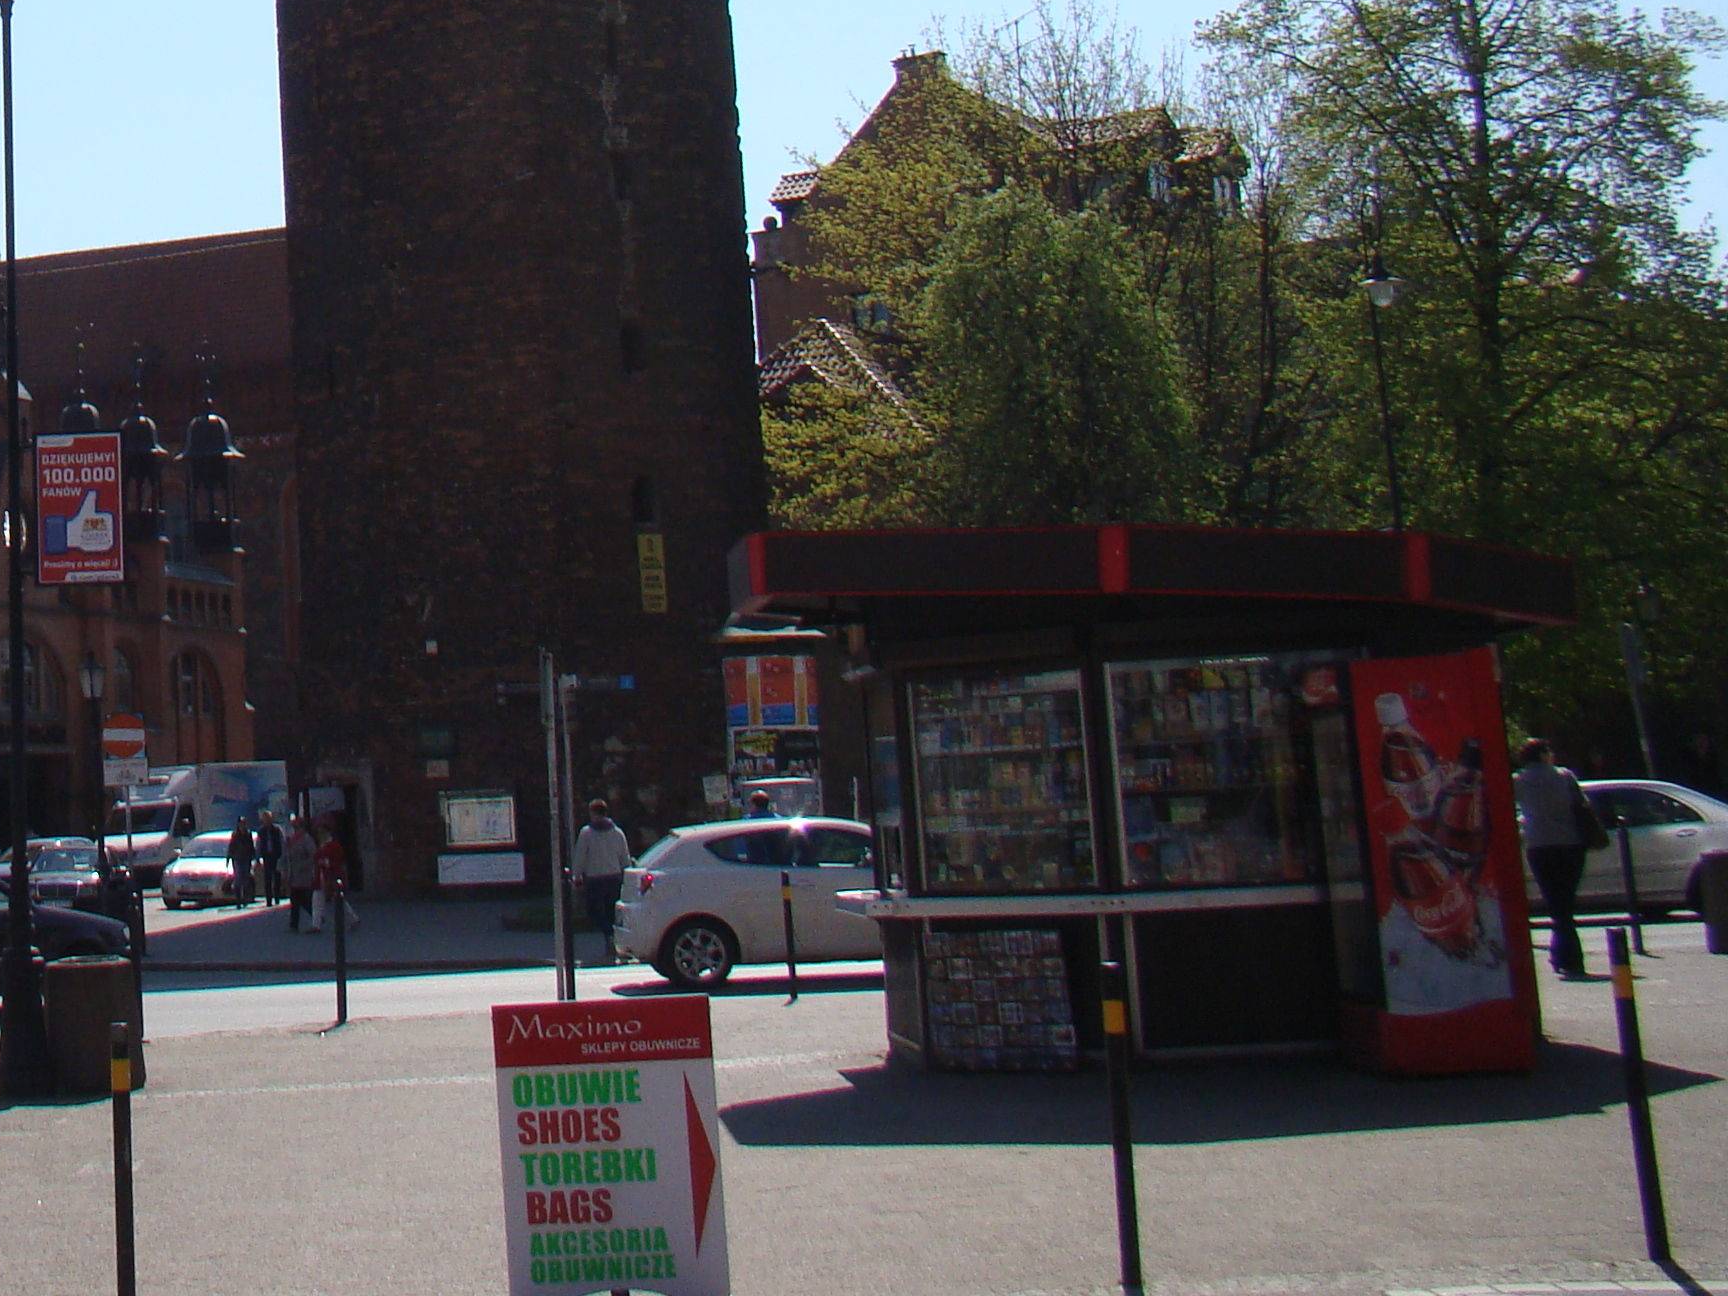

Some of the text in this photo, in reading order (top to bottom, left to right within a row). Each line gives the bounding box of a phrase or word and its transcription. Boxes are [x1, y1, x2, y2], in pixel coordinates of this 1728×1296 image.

[41, 451, 115, 465] DZIĘKUJEMY!
[41, 485, 82, 497] FANÓW
[42, 466, 116, 484] 100.000
[506, 1013, 643, 1045] Maximo
[581, 1037, 702, 1055] SKLEPY OBUWNICZE
[512, 1068, 642, 1107] OBUWIE
[516, 1107, 621, 1145] SHOES
[519, 1147, 658, 1186] TOREBKI
[525, 1187, 613, 1225] BAGS
[530, 1226, 670, 1258] AKCESORIA
[530, 1253, 678, 1284] OBUWNICZE
